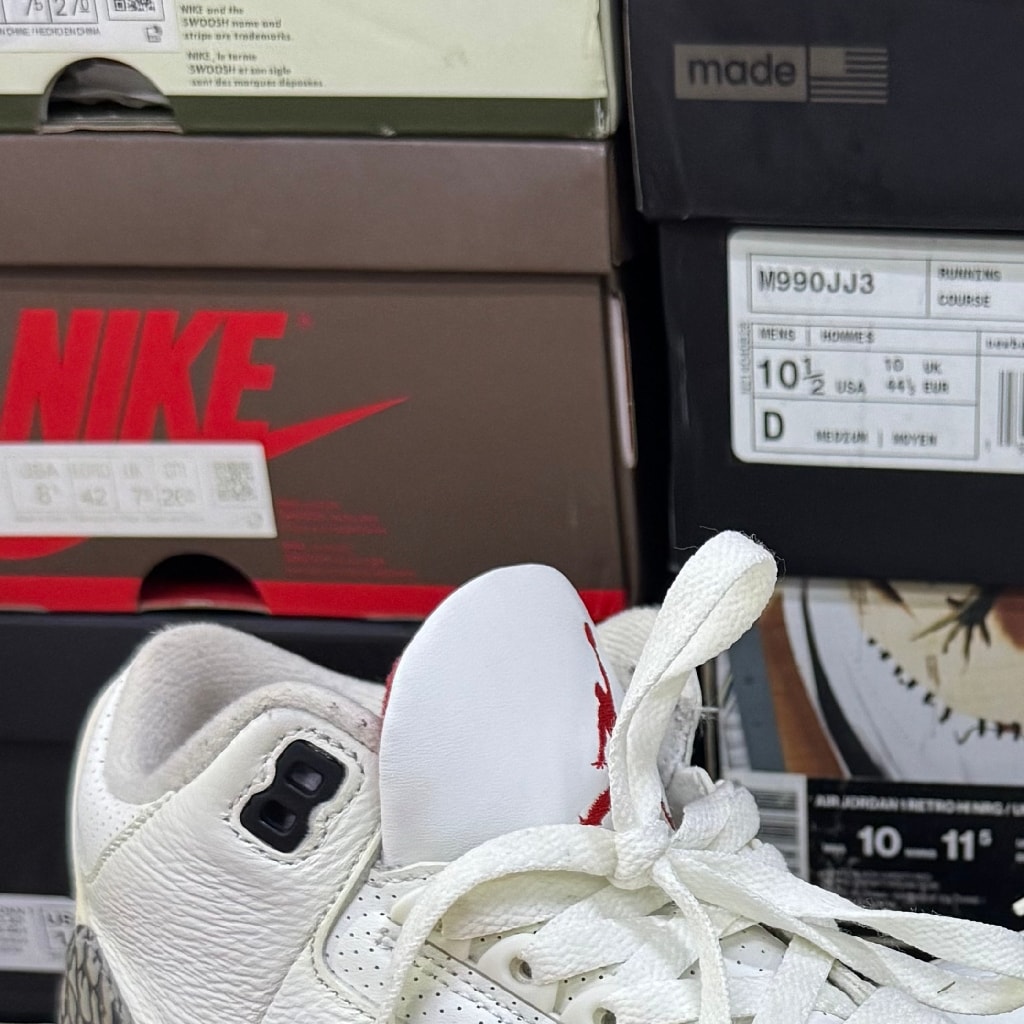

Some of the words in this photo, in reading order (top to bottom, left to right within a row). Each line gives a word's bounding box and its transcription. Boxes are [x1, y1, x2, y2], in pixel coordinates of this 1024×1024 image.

[181, 5, 203, 15] NIKE
[207, 6, 226, 15] and
[229, 6, 244, 15] the
[182, 18, 230, 28] SWOOSH
[232, 20, 260, 28] name
[262, 19, 282, 28] and
[215, 33, 231, 41] are
[228, 53, 258, 62] terme
[189, 65, 237, 75] SWOOSH
[688, 53, 797, 87] made
[759, 270, 876, 296] M990JJ3
[937, 267, 1002, 283] RUNNING
[937, 293, 992, 309] COURSE
[760, 328, 797, 343] MENS
[820, 329, 876, 345] HOMMES
[884, 357, 905, 373] 10
[922, 359, 944, 375] UK
[1, 308, 289, 443] NIKE
[834, 378, 868, 395] USA
[922, 379, 951, 396] EUR
[763, 410, 786, 442] D
[815, 429, 870, 446] MEDIUM
[891, 431, 939, 447] MOYEN
[841, 795, 899, 812] JORDAN
[908, 797, 956, 815] RETRO
[856, 825, 903, 858] 10
